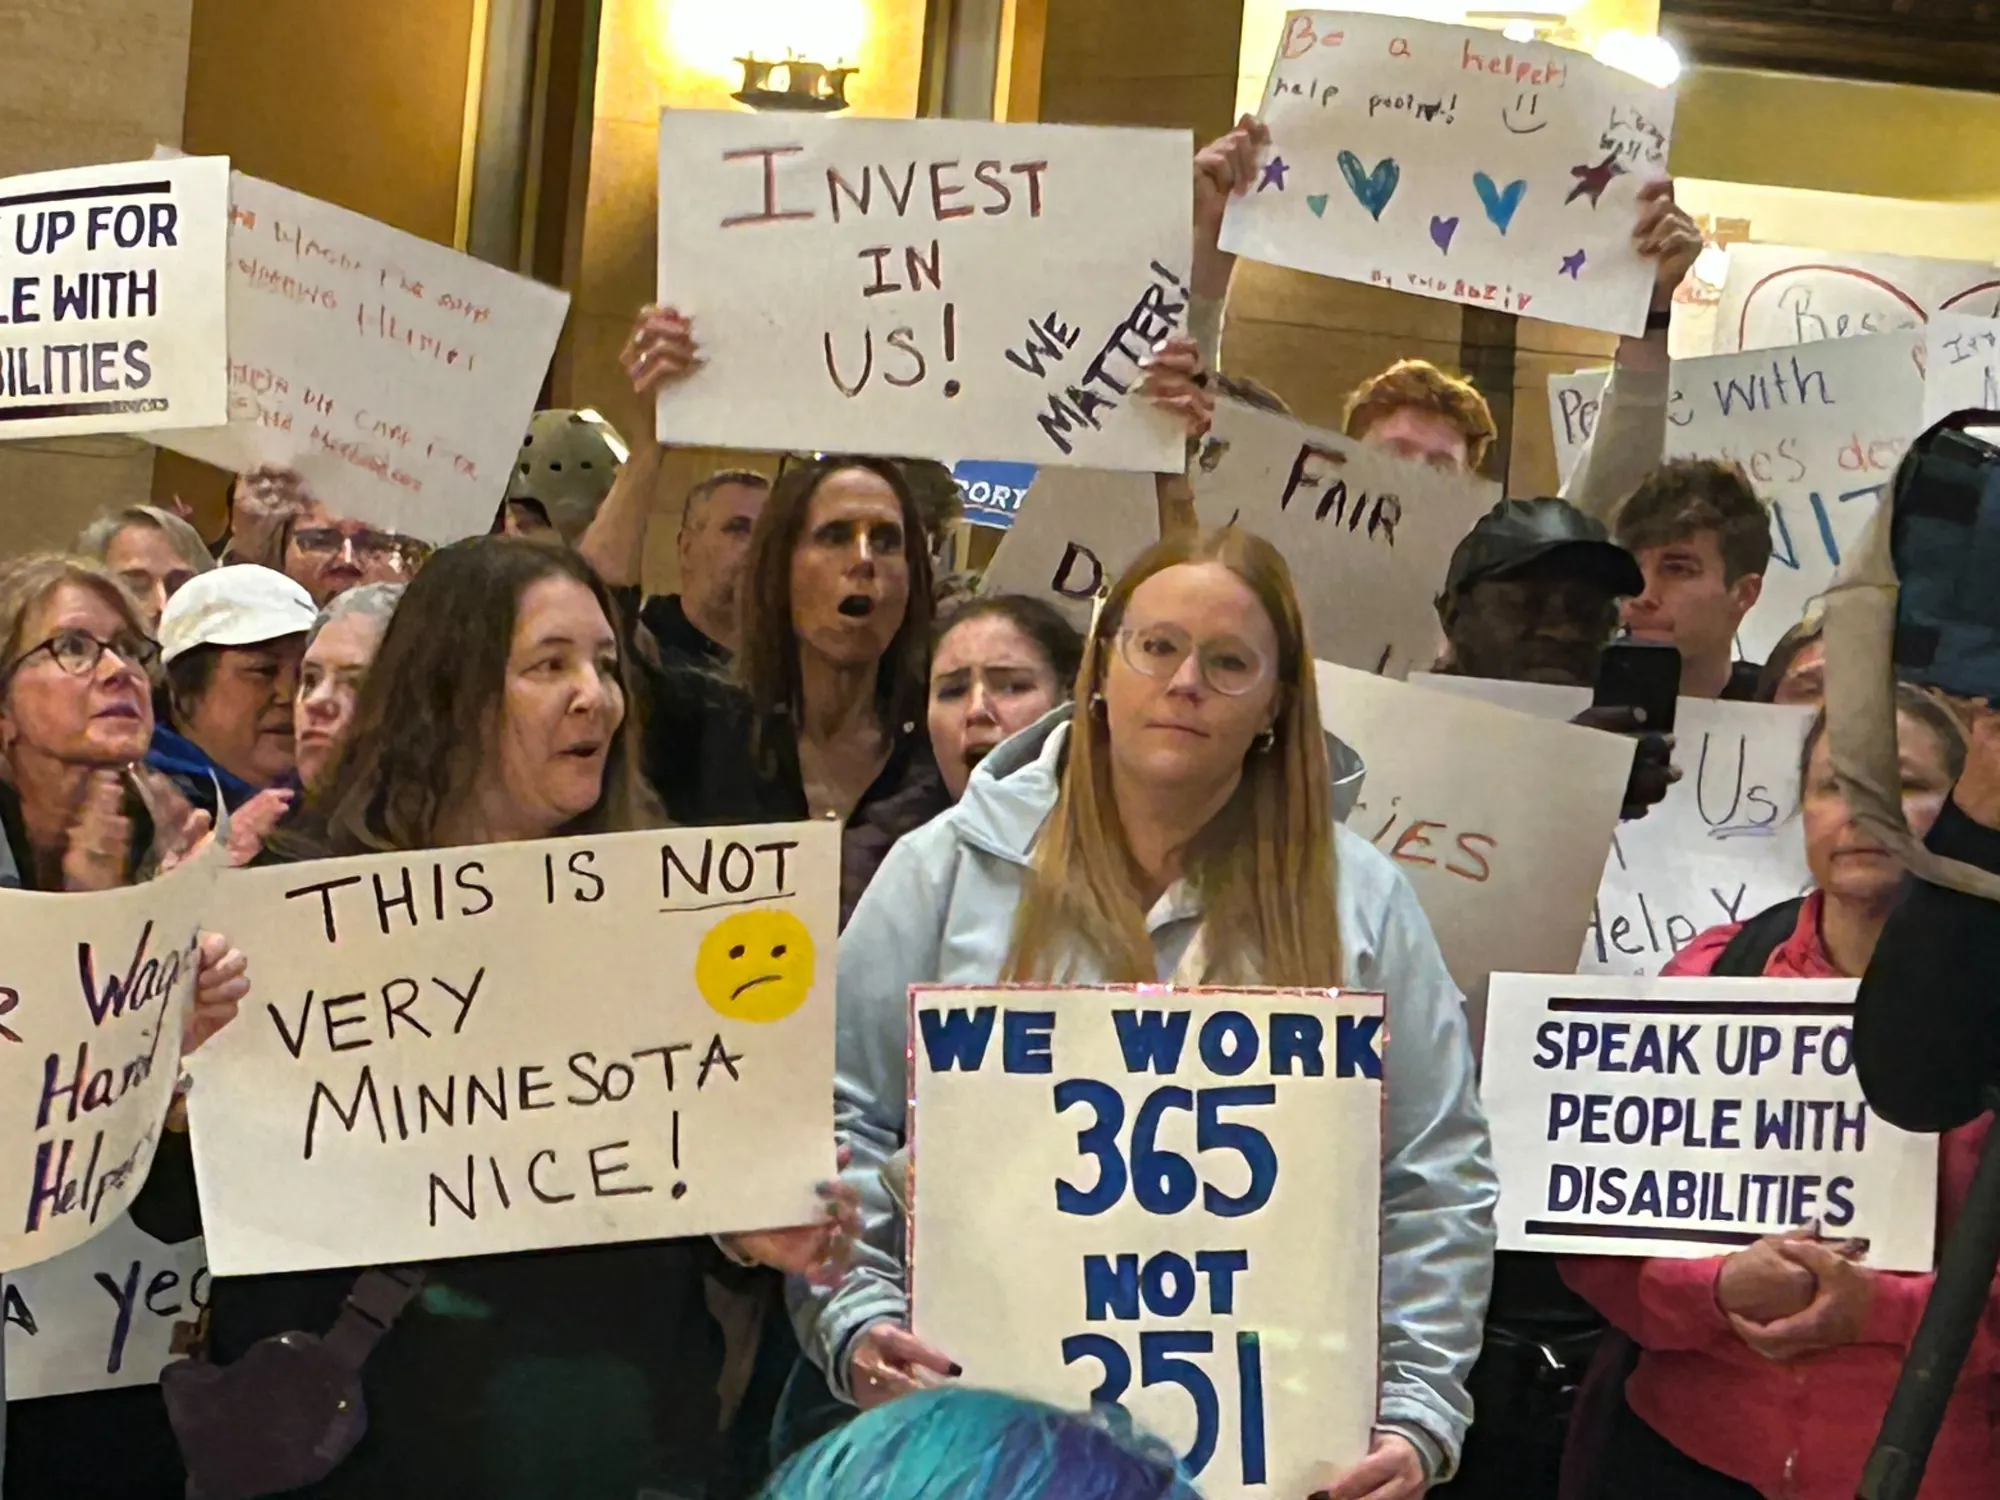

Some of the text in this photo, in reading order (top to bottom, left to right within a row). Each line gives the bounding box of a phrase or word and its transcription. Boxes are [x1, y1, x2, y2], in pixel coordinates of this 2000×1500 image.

[1281, 13, 1343, 60] Be
[1388, 36, 1412, 58] a
[1272, 76, 1341, 109] help
[720, 145, 1049, 228] INVEST
[15, 210, 75, 254] UP
[87, 202, 178, 251] FOR
[53, 268, 157, 321] WITH
[858, 239, 941, 297] IN
[0, 339, 152, 397] ILITIES
[823, 302, 961, 399] US!
[1004, 310, 1081, 379] WE
[1036, 260, 1190, 456] MATTER!
[1713, 356, 1835, 416] with
[1281, 443, 1402, 549] FAIR
[1697, 732, 1778, 828] Us
[285, 838, 800, 943] THIS IS NOT
[266, 966, 487, 1060] VERY
[918, 1005, 1385, 1080] WE WORK
[1533, 1021, 1854, 1076] SPEAK UP FO
[302, 1032, 745, 1160] MINNESOTA
[1547, 1093, 1866, 1152] PEOPLE WITH
[427, 1110, 691, 1228] NICE!
[1053, 1078, 1279, 1218] 365
[1547, 1163, 1856, 1228] DISABILITIES
[3, 1283, 39, 1336] A
[1083, 1249, 1249, 1321] NOT
